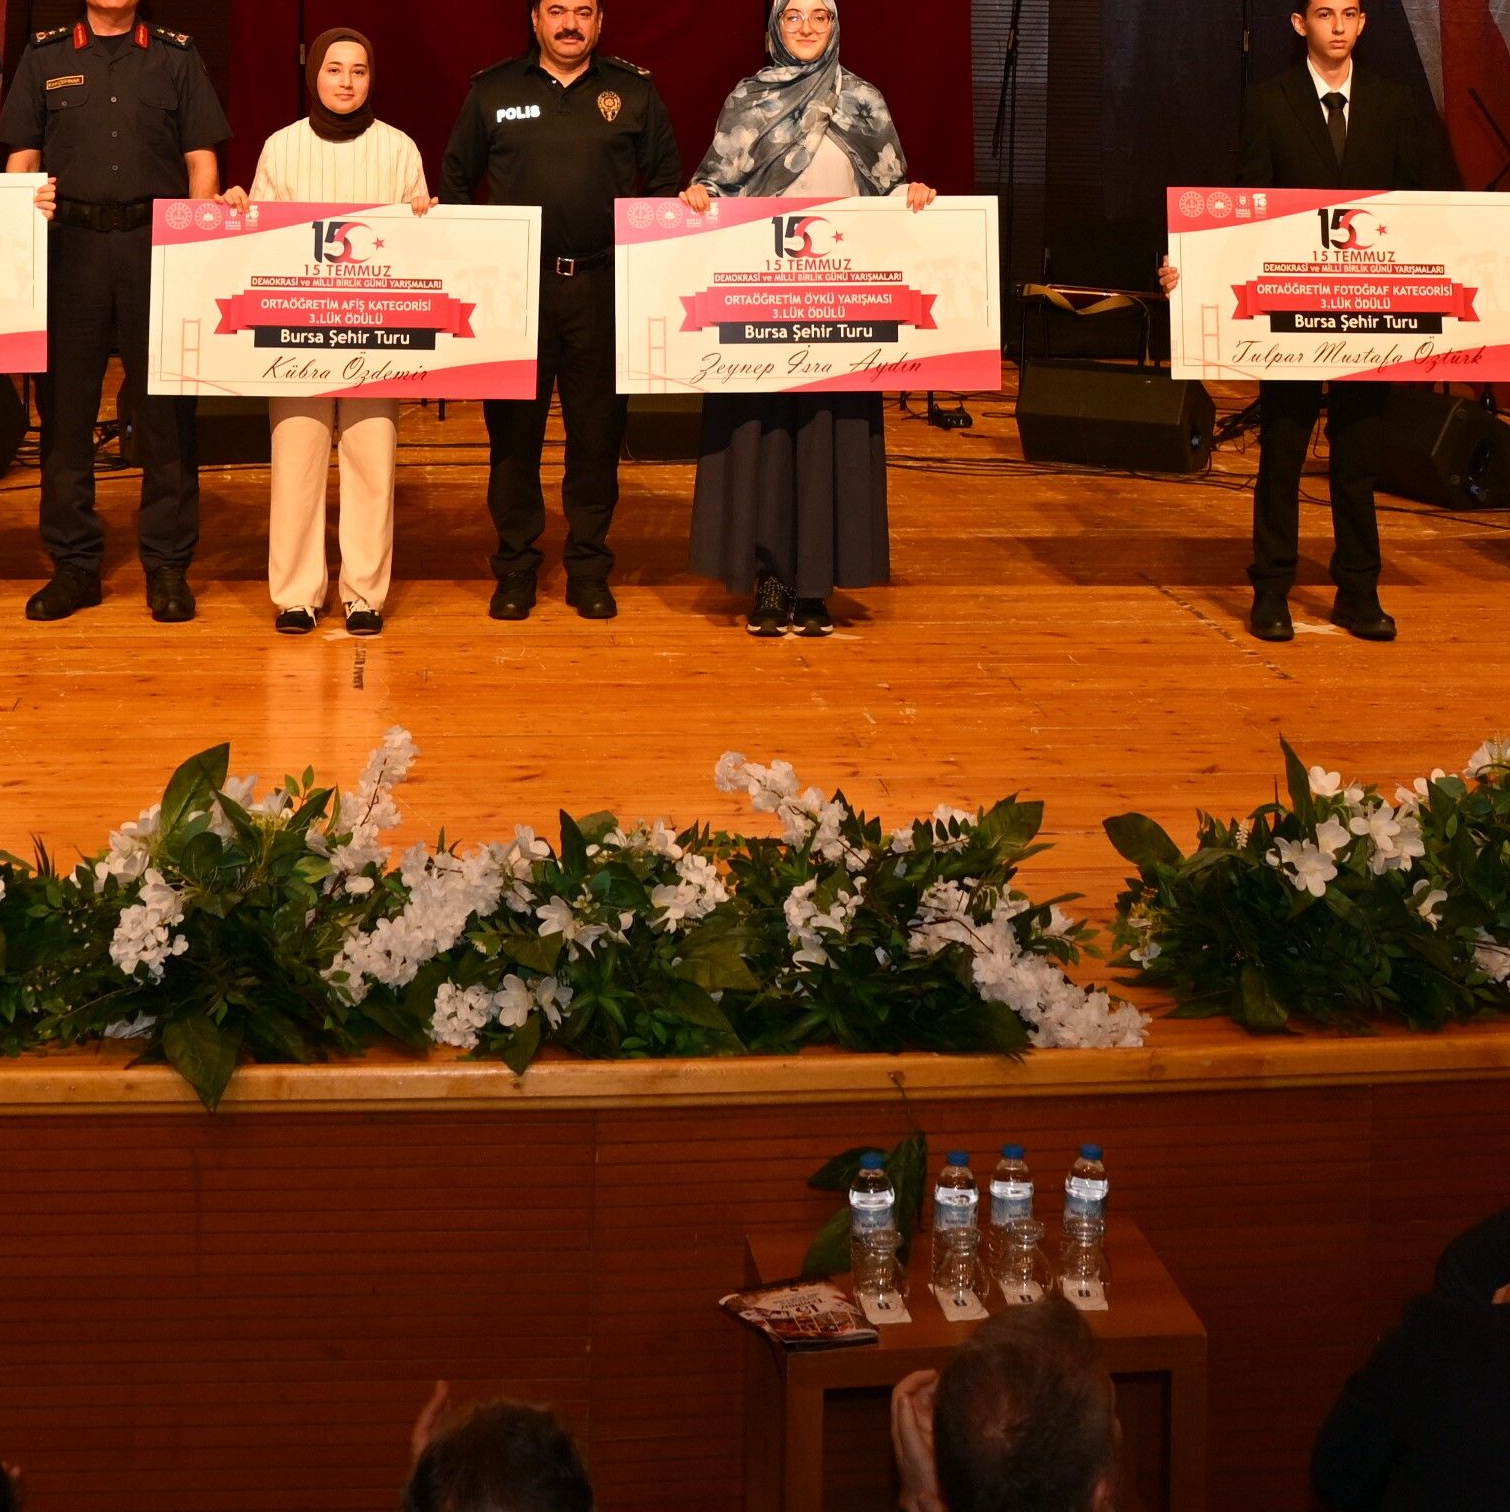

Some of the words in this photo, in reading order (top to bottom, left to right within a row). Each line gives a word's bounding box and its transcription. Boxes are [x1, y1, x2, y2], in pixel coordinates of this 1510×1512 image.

[1313, 251, 1328, 261] 15
[1334, 251, 1395, 262] TEMMUZ
[305, 264, 320, 276] 15
[327, 264, 391, 277] TEMMUZ
[766, 259, 781, 271] 15
[787, 259, 851, 270] TEMMUZ
[1257, 283, 1331, 294] ORTAÖĞRETİM
[1334, 283, 1390, 295] FOTOĞRAF
[1393, 284, 1452, 296] KATEGORİSİ
[261, 298, 339, 310] ORTAÖĞRETİM
[342, 299, 365, 312] AFİŞ
[368, 299, 431, 311] KATEGORİSİ
[725, 294, 801, 305] ORTAÖĞRETİM
[805, 293, 835, 304] ÖYKÜ
[838, 294, 892, 306] YARIŞMASI
[1321, 298, 1352, 309] 3.LÜK
[1355, 298, 1390, 309] ÖDÜLÜ
[309, 312, 341, 323] 3.LÜK
[345, 313, 383, 324] ÖDÜLÜ
[773, 307, 805, 319] 3.LÜK
[808, 307, 845, 318] ÖDÜLÜ
[1295, 314, 1336, 328] Bursa
[1341, 315, 1379, 332] Şehir
[1384, 315, 1418, 328] Turu
[281, 329, 323, 343] Bursa
[329, 330, 369, 347] Şehir
[375, 331, 410, 345] Turu
[745, 325, 788, 339] Bursa
[793, 325, 832, 341] Şehir
[838, 324, 872, 337] Turu
[262, 356, 331, 379] Kübra
[342, 351, 428, 388] Özdemir
[691, 353, 775, 384] Zeynep
